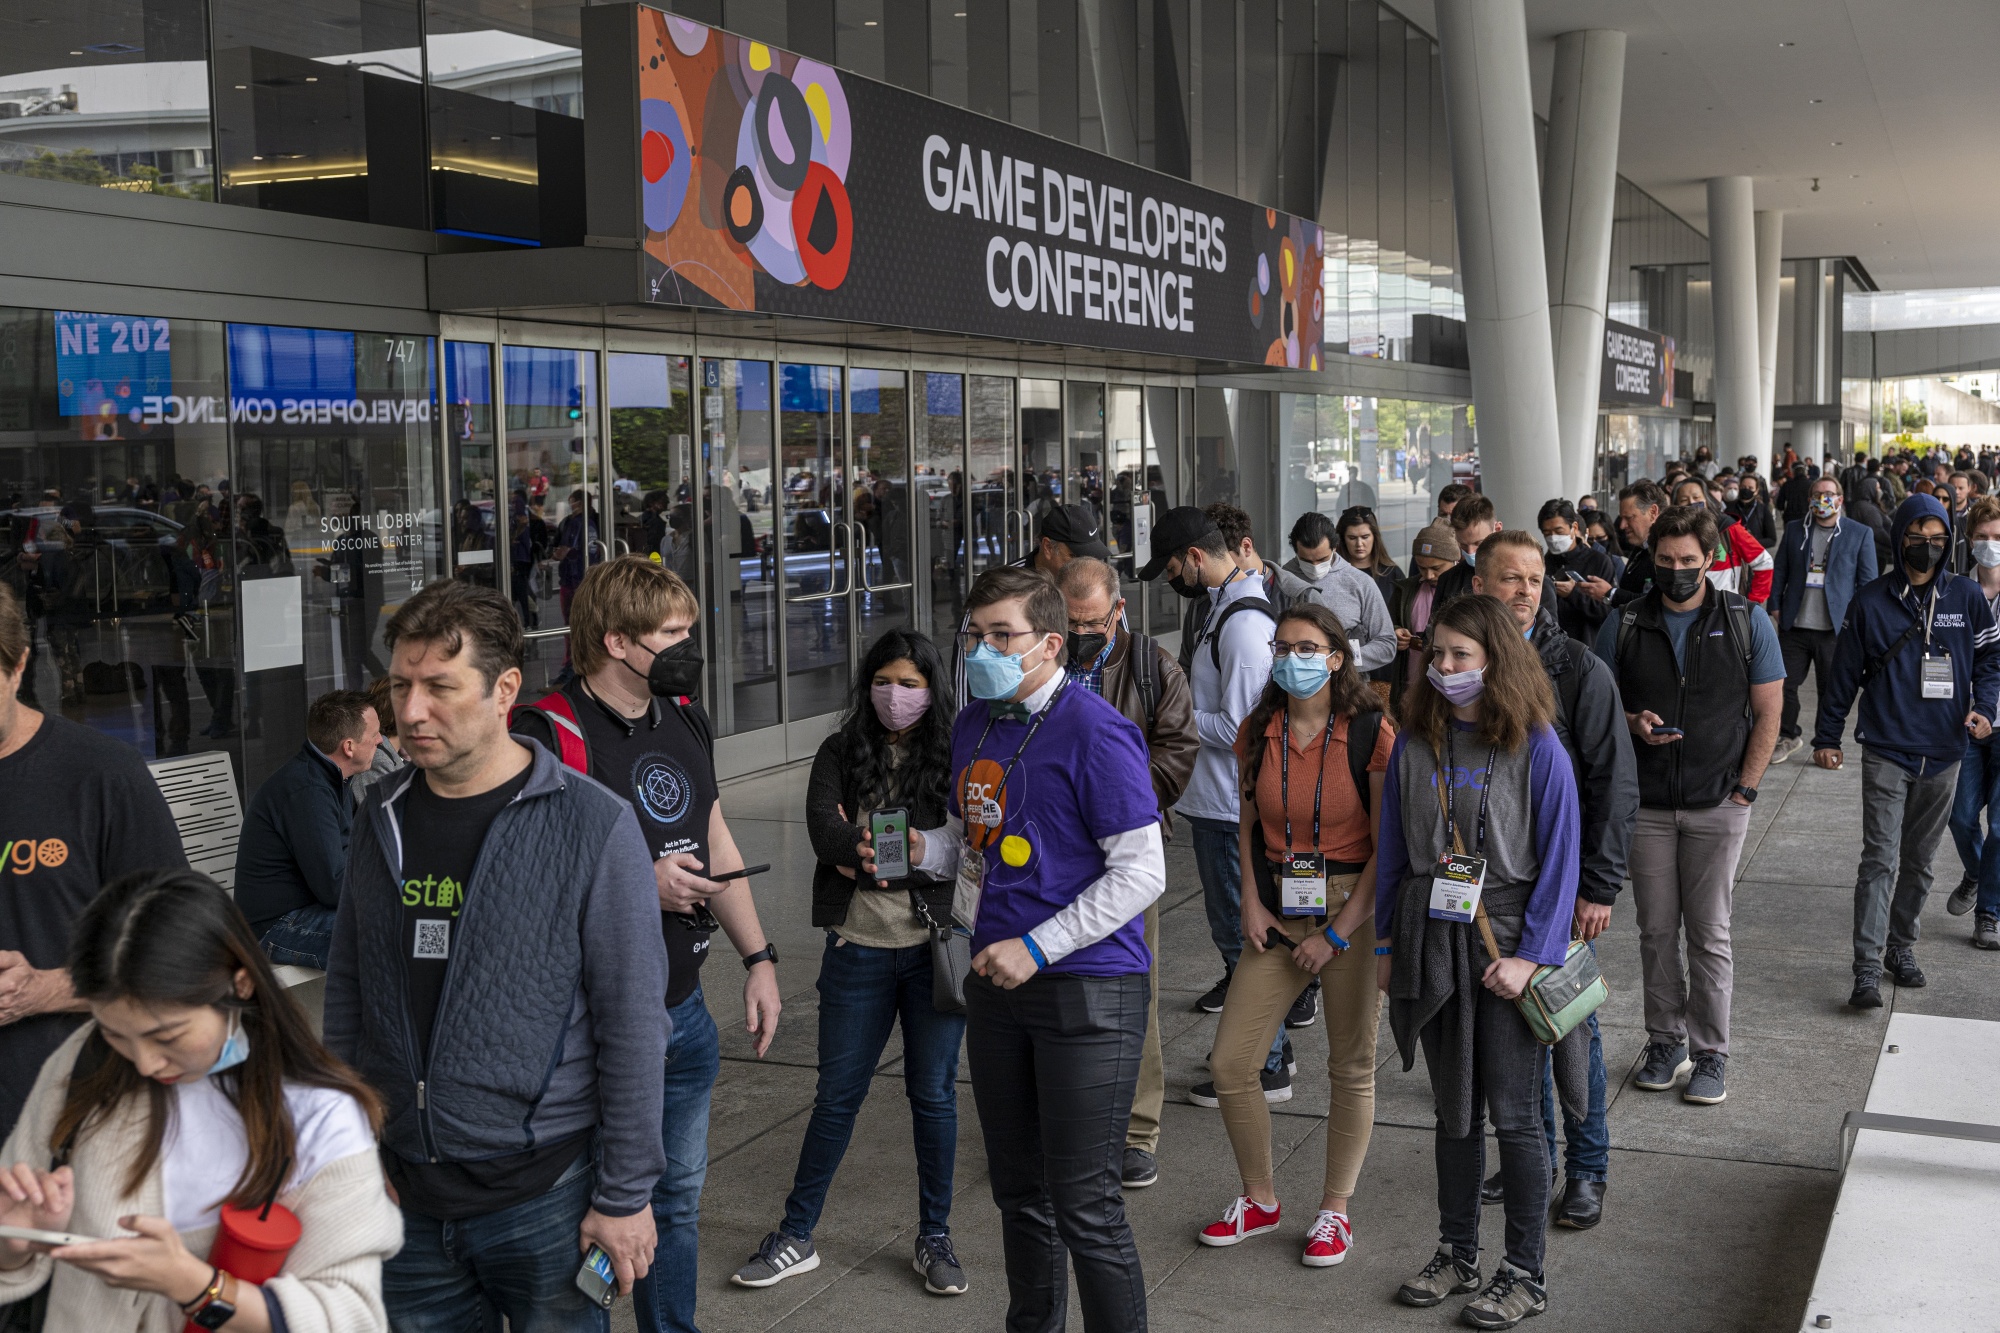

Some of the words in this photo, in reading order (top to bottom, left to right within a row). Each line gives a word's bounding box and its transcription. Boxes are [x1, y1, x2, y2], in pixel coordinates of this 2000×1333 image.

[923, 134, 1036, 231] GAME
[1043, 167, 1227, 273] DEVELOPERS
[986, 236, 1194, 332] CONFERENCE
[111, 319, 170, 353] 202
[1607, 330, 1623, 360] GAME
[384, 339, 415, 363] 747
[1615, 363, 1650, 395] CONFERENCE
[320, 514, 371, 533] SOUTH
[376, 512, 421, 529] LOBBY
[321, 537, 379, 552] MOSCONE
[382, 534, 422, 548] CENTER
[966, 782, 992, 802] GDC
[983, 803, 997, 813] HE
[665, 841, 674, 849] Act
[1292, 860, 1315, 869] GDC
[1447, 862, 1473, 874] GDC
